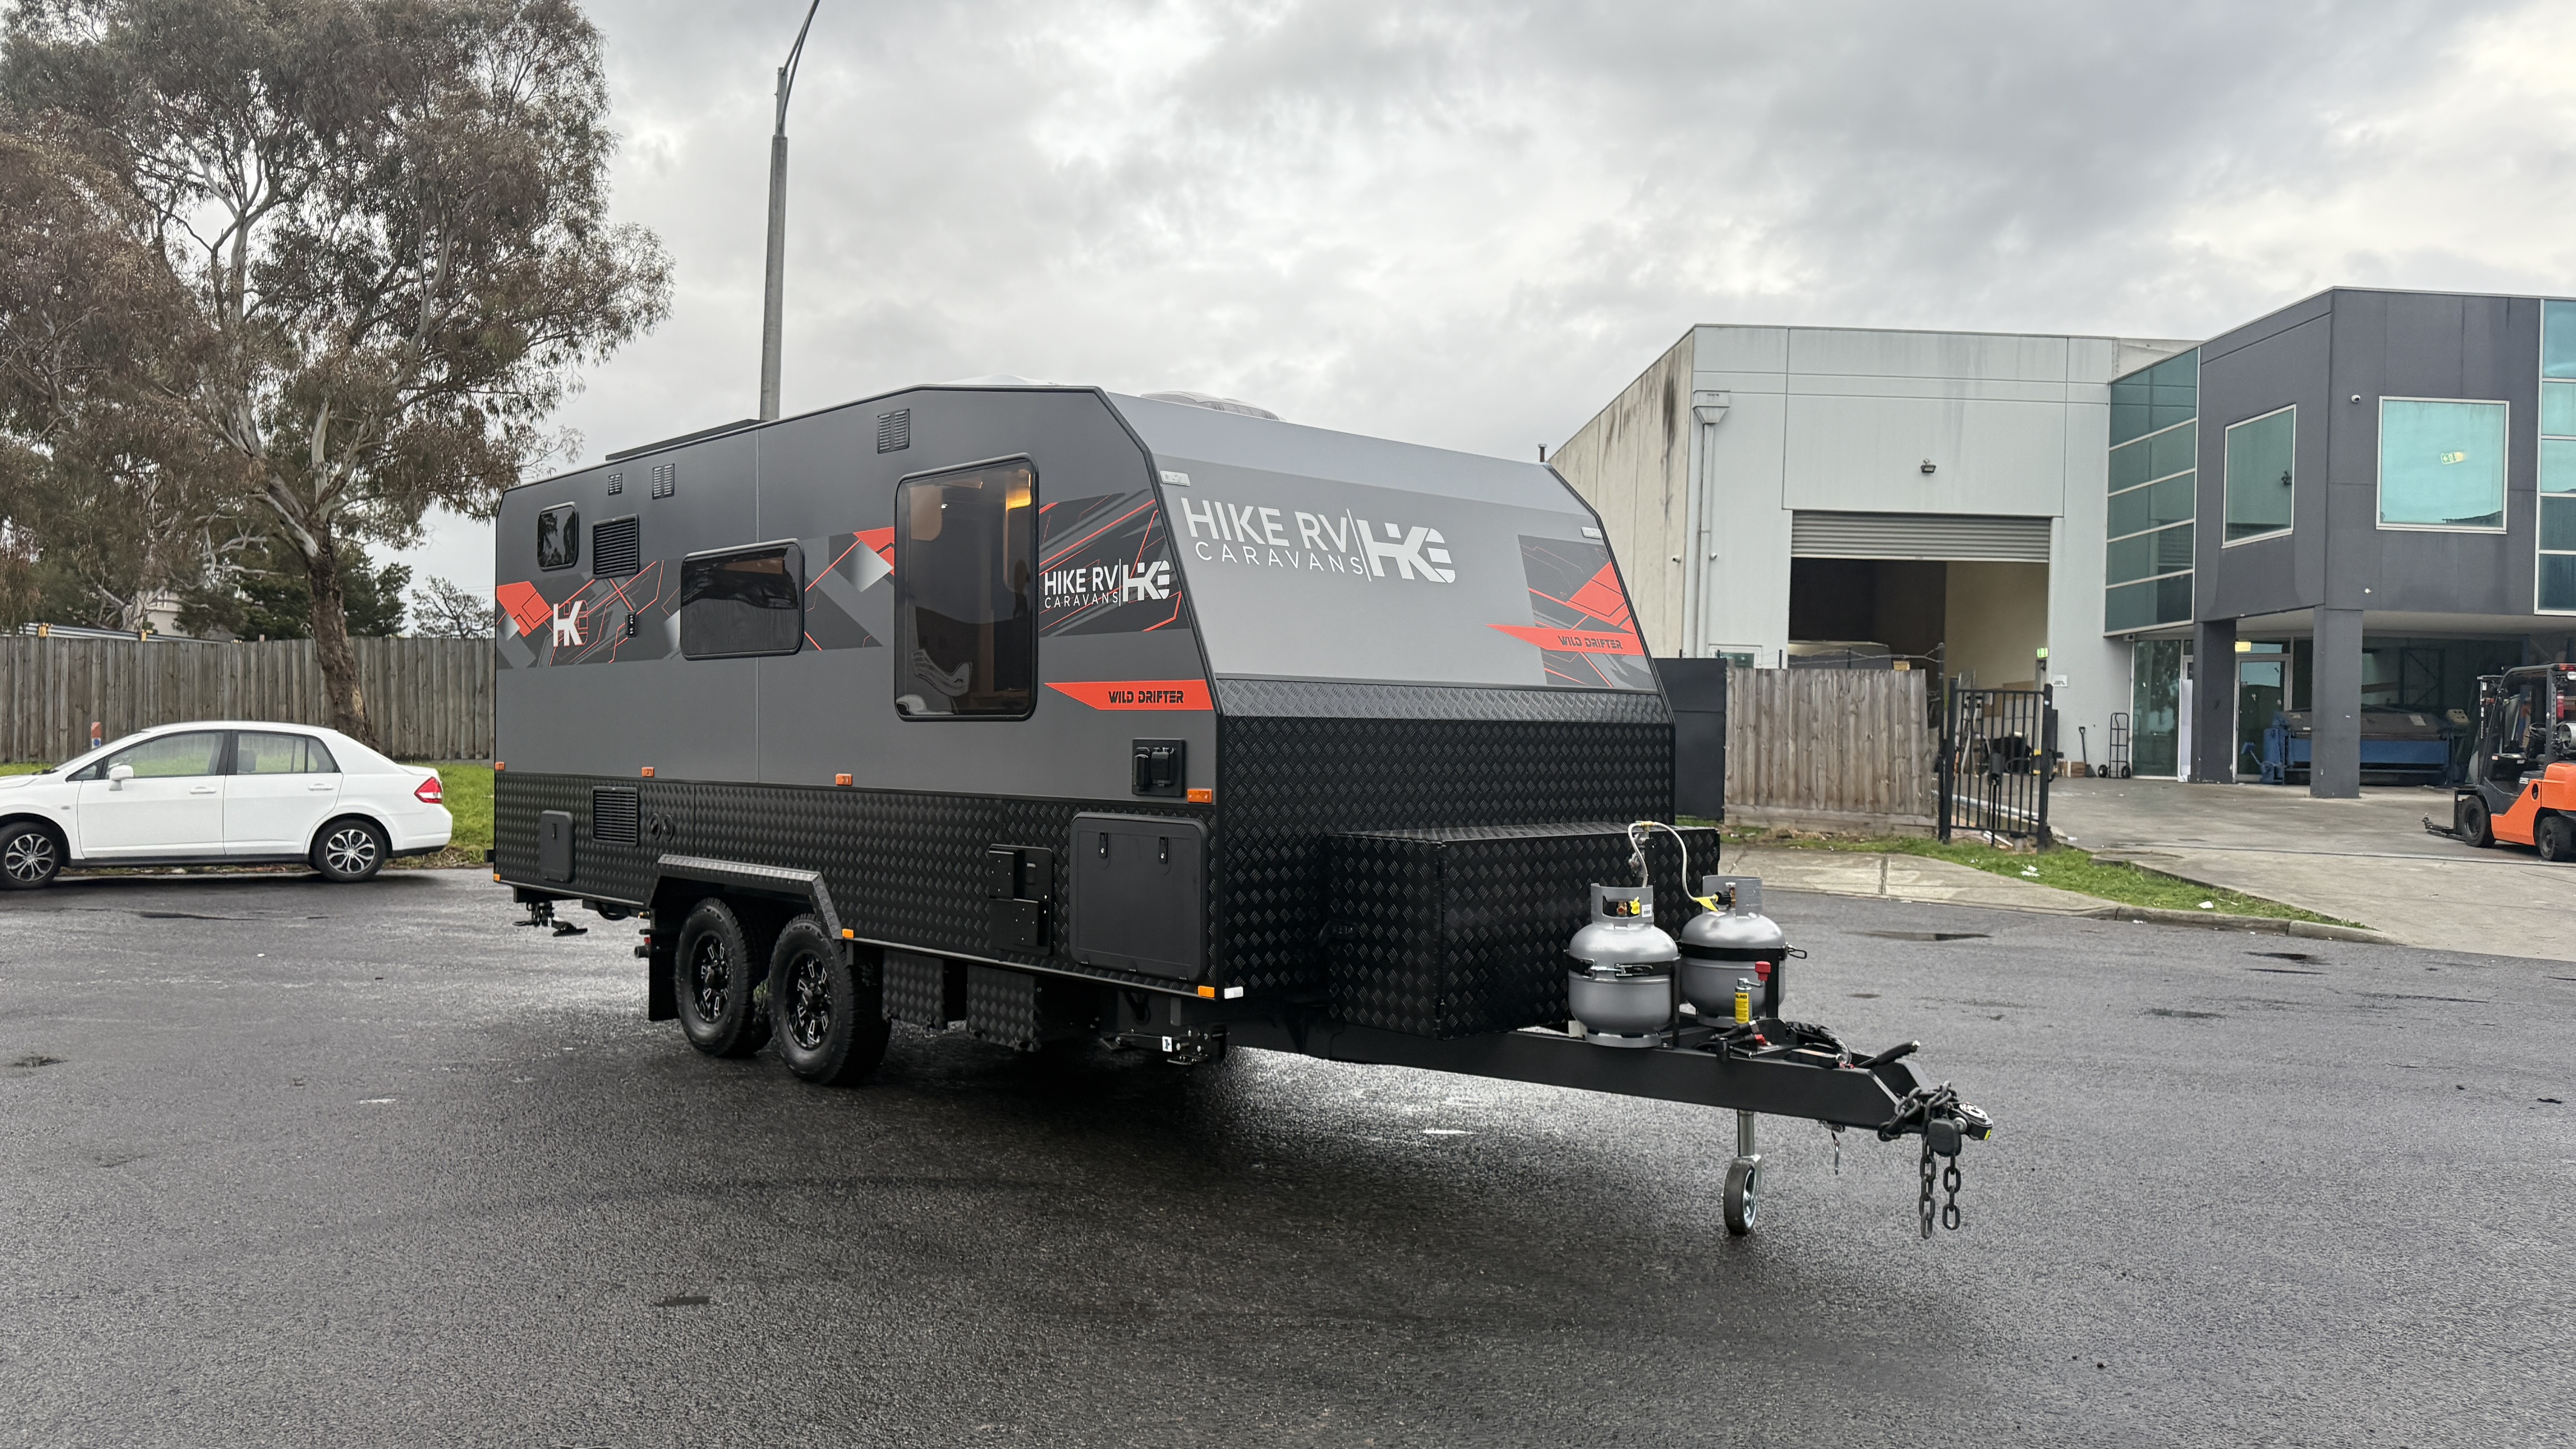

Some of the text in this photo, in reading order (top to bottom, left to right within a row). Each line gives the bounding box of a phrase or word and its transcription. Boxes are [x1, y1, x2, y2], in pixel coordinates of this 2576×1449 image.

[1181, 497, 1348, 553] HIKE RV
[1195, 541, 1363, 575] CARAVANS
[1044, 564, 1119, 596] HIKE RV
[1044, 591, 1118, 609] CARAVANS
[1558, 635, 1624, 649] WILD DRIFTER
[1108, 690, 1184, 704] WILD DRIFTER
